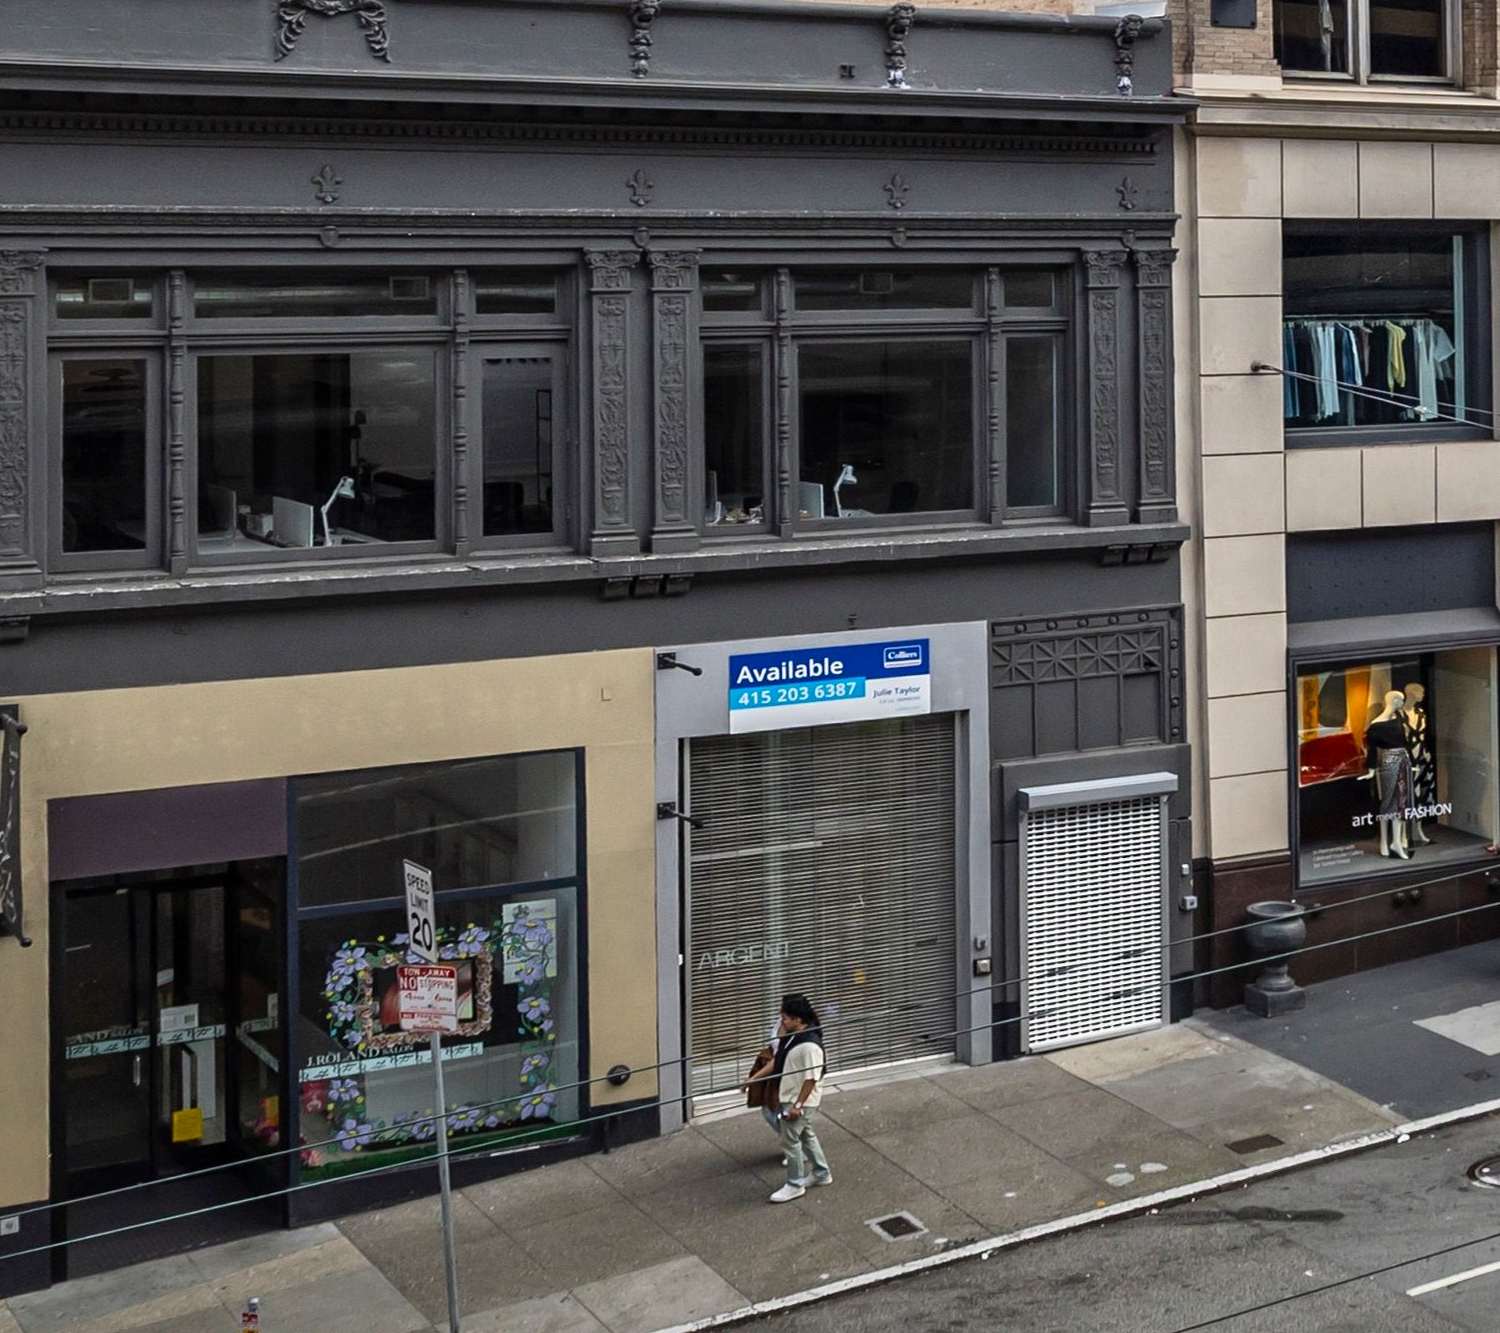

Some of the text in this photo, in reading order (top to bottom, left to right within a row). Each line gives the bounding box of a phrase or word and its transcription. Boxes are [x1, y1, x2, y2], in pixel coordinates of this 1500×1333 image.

[736, 657, 844, 685] Available
[738, 681, 857, 706] 415 203 6387
[872, 685, 921, 700] Julie Taylor
[1351, 812, 1374, 828] art
[1404, 802, 1453, 820] FASHION
[406, 872, 430, 895] SPEED
[410, 891, 429, 913] LIMIT
[411, 912, 433, 952] 20
[400, 977, 417, 991] NO
